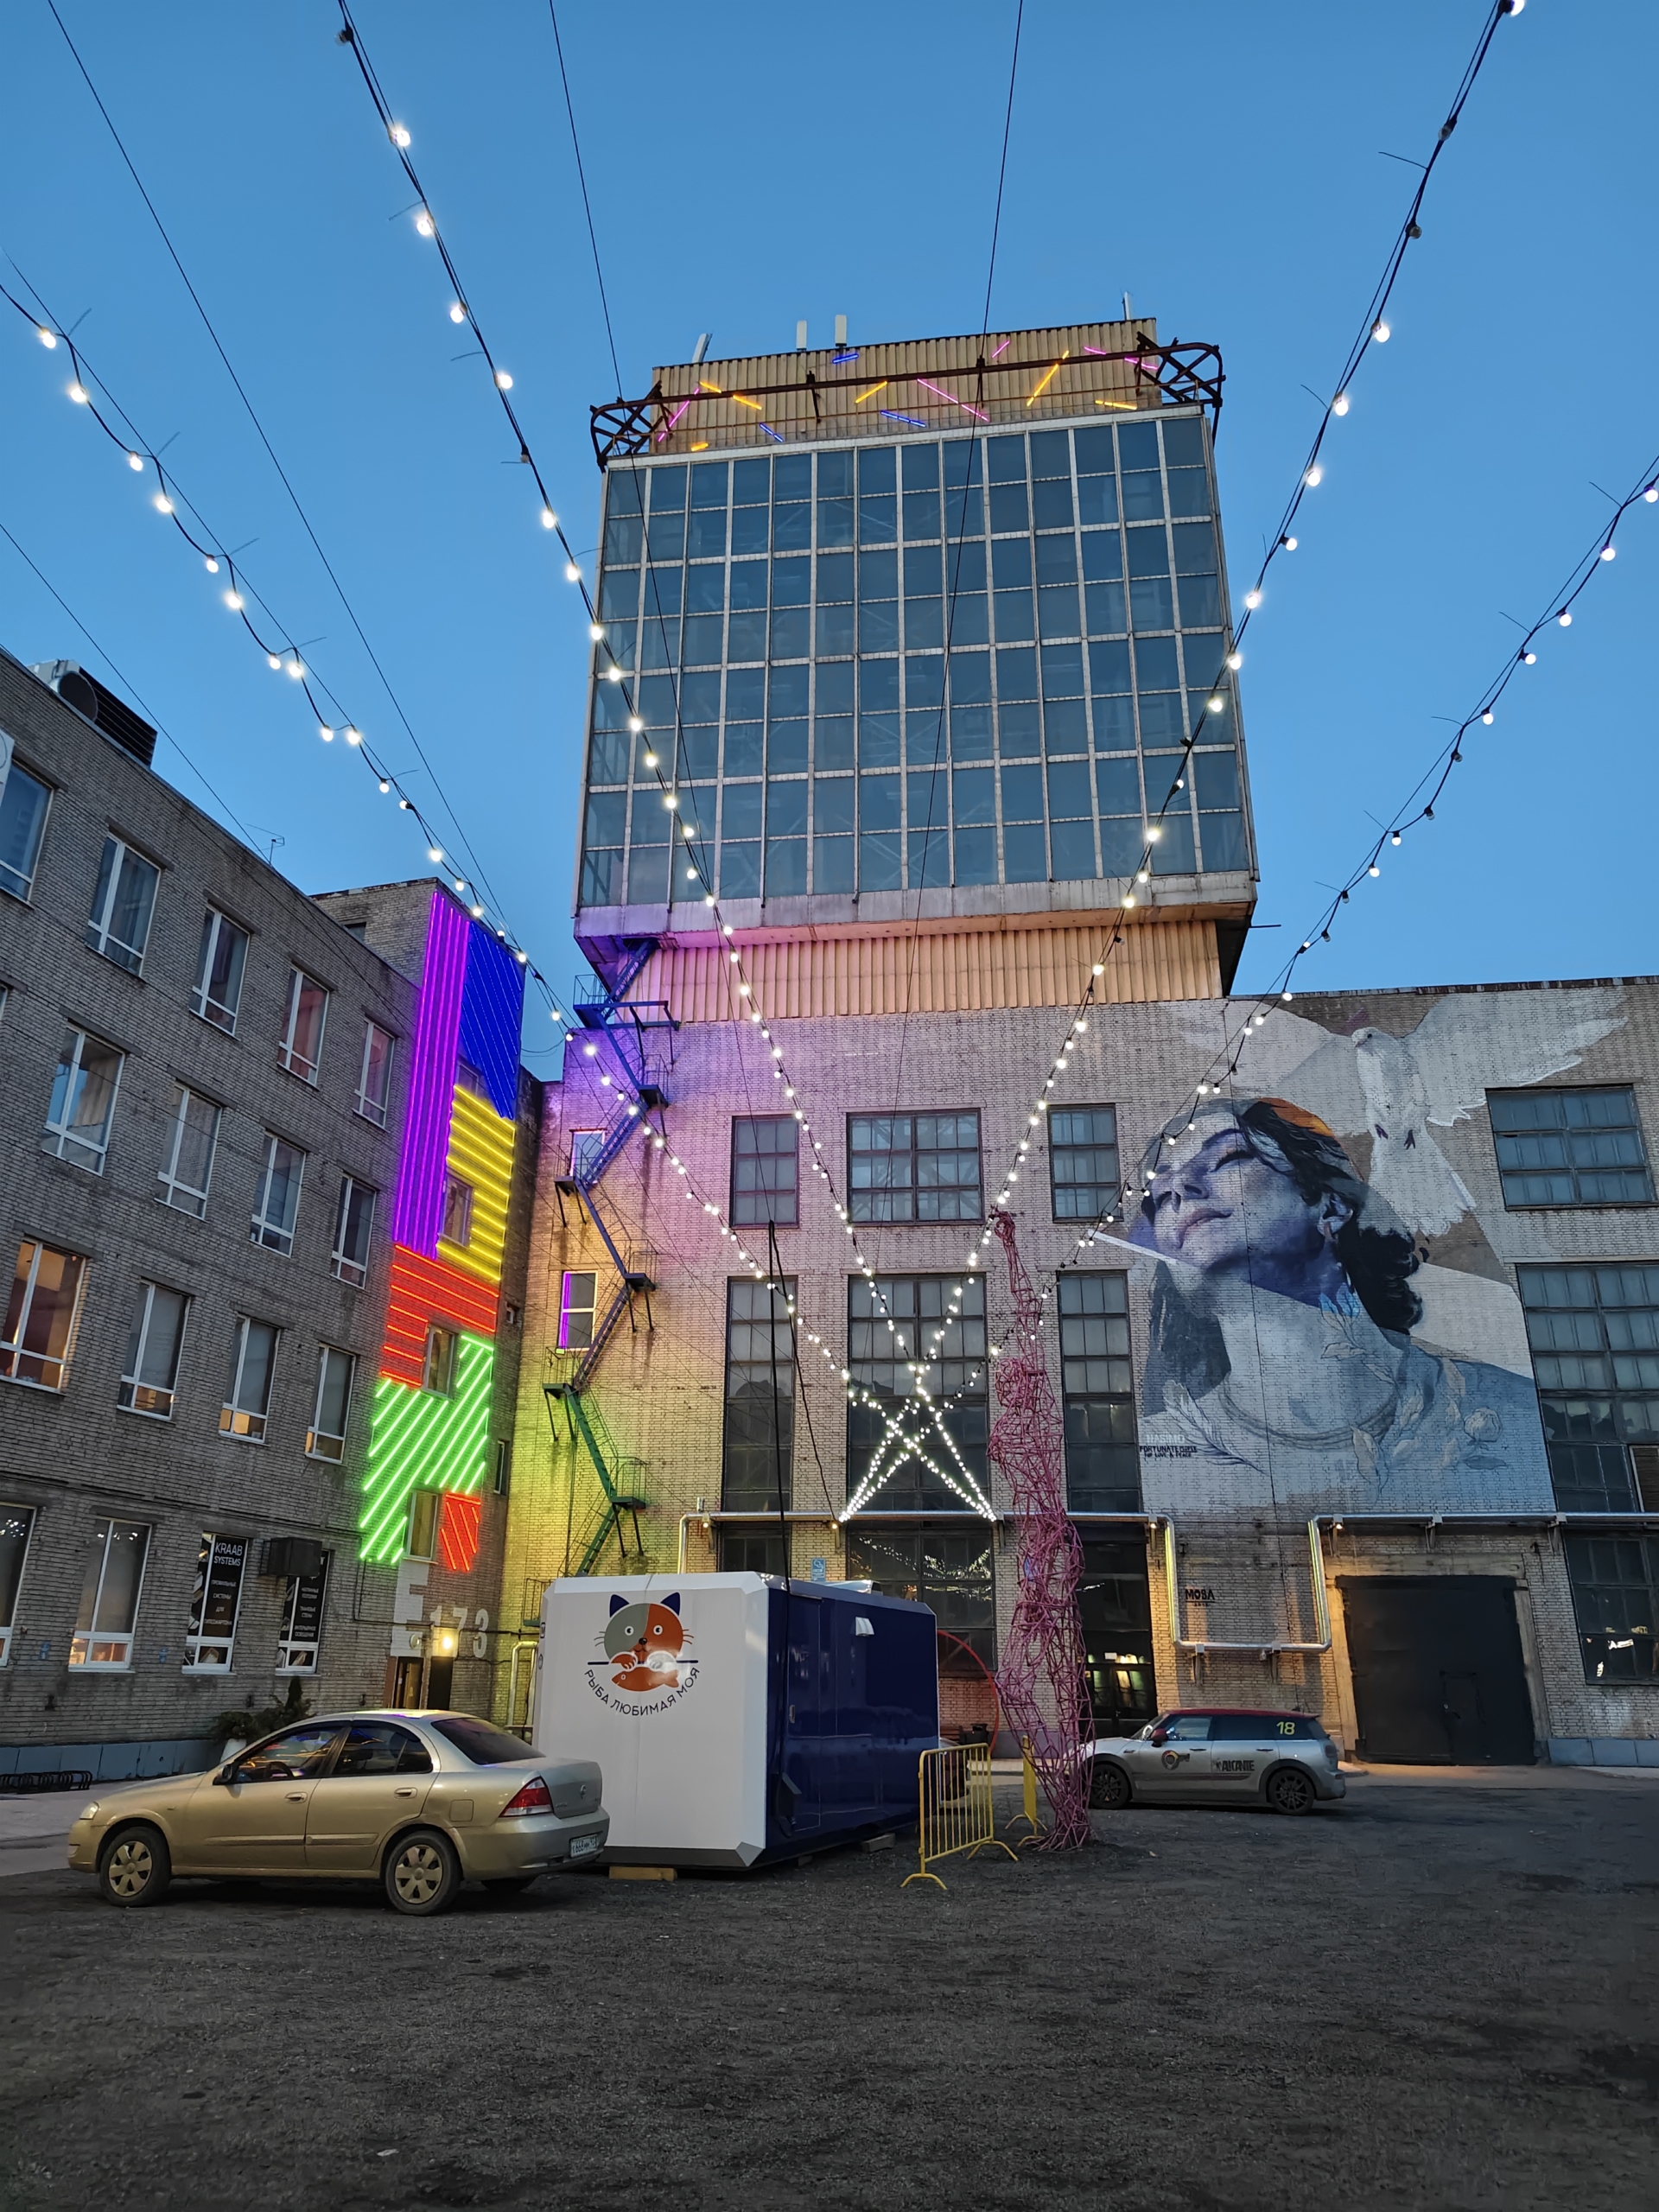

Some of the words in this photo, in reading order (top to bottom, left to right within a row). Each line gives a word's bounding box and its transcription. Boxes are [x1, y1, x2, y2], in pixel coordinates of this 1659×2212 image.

[215, 1541, 243, 1555] KRAAB
[213, 1555, 241, 1566] SYSTEMS
[584, 1669, 610, 1705] РЫБА
[610, 1694, 677, 1716] ЛЮБИМАЯ
[676, 1667, 701, 1699] МОЯ
[1276, 1721, 1295, 1735] 18
